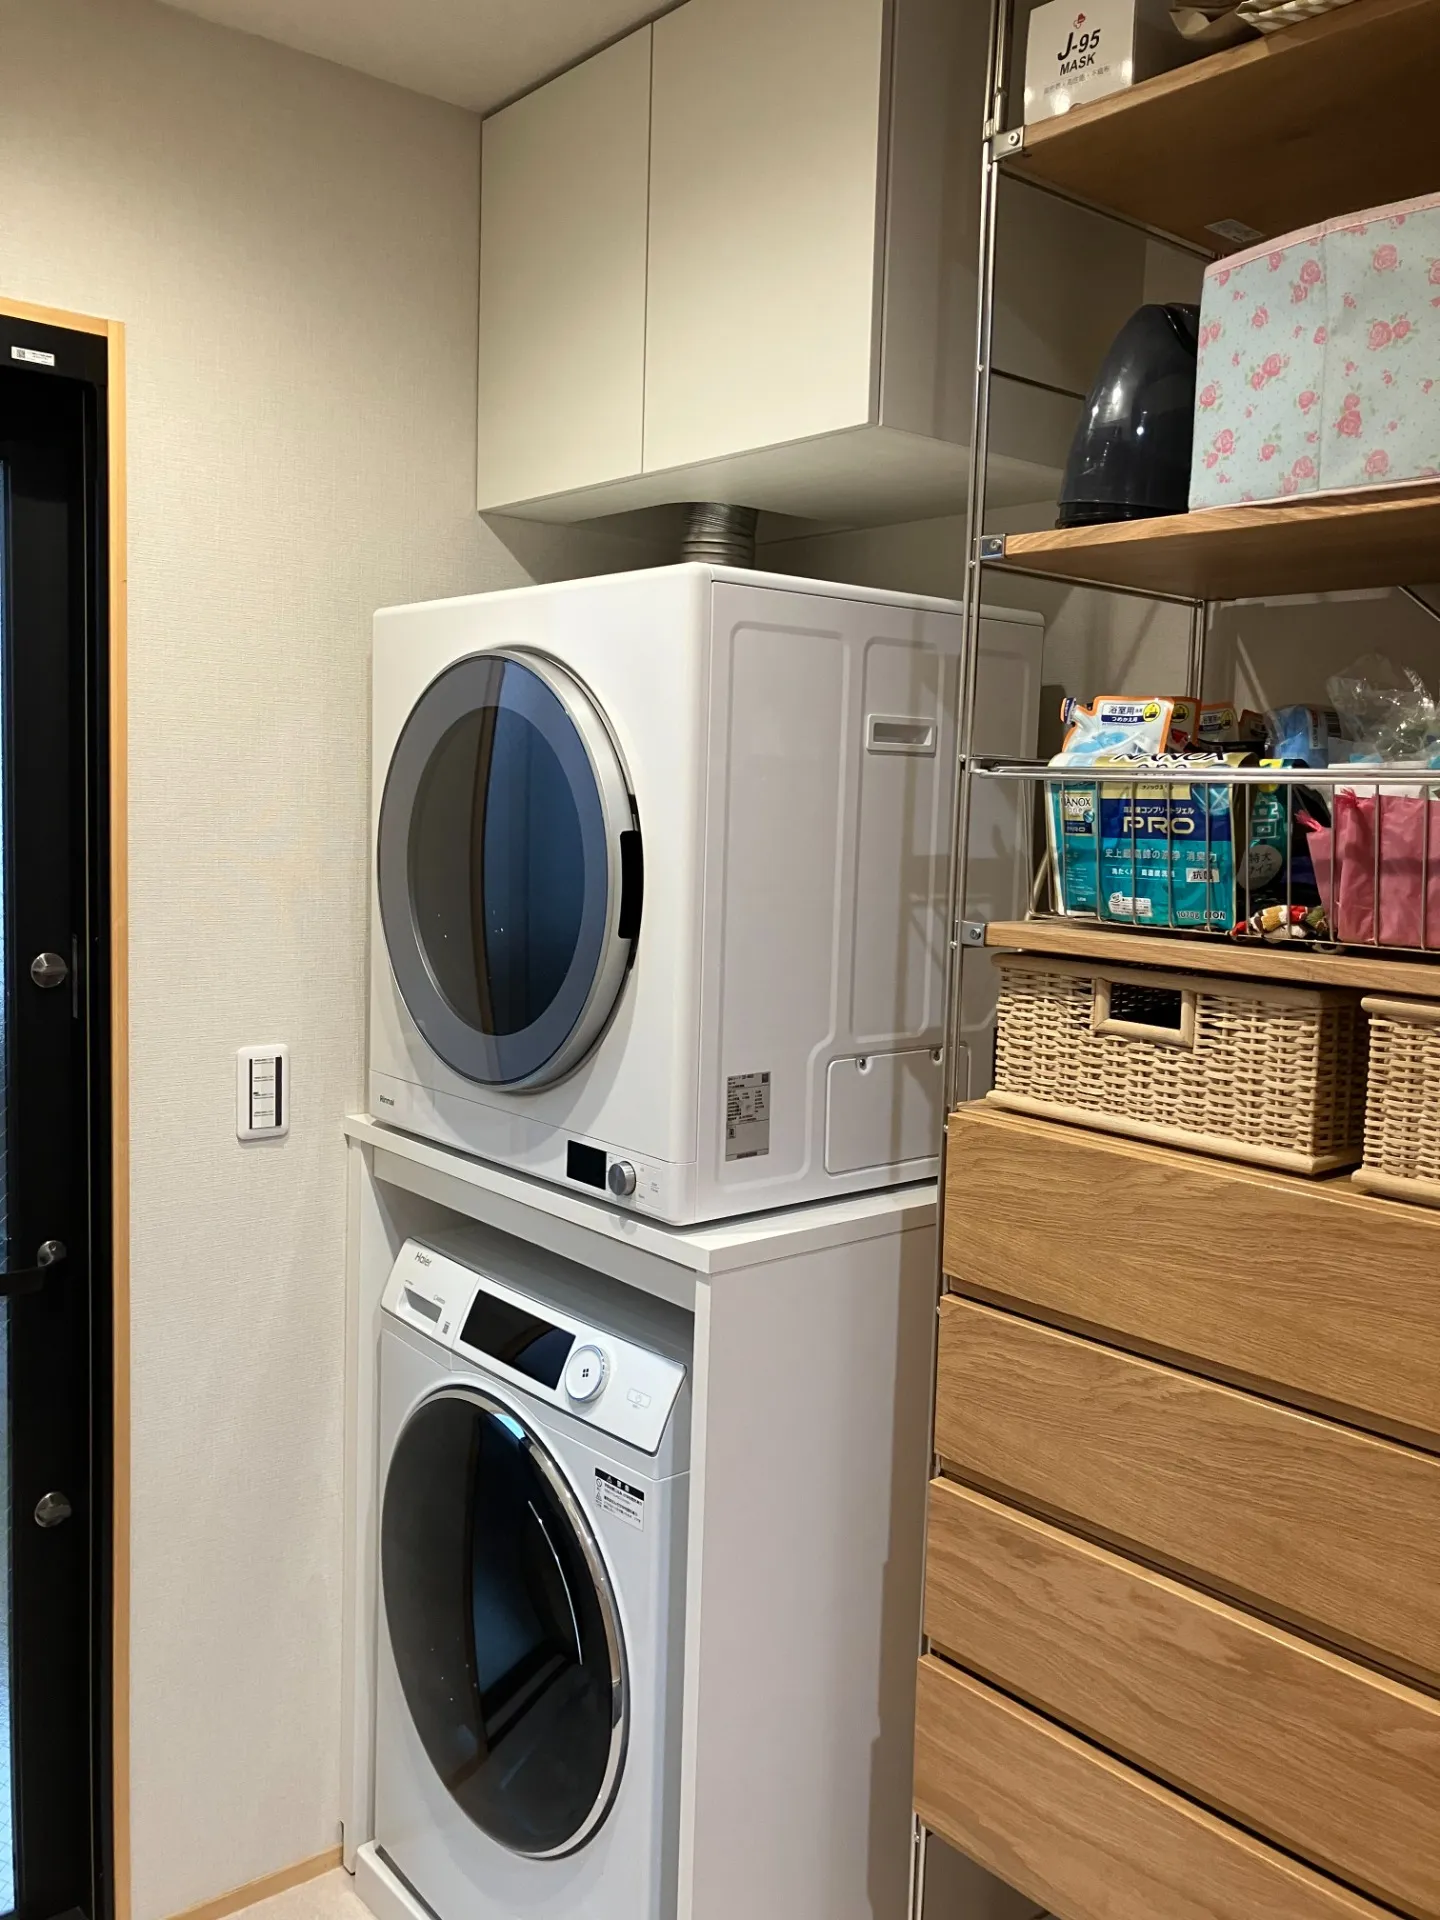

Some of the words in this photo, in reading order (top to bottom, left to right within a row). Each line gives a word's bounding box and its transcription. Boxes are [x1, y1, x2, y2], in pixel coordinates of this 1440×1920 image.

[1057, 28, 1101, 60] J-95
[1059, 52, 1096, 76] MASK
[1123, 816, 1195, 835] PRO
[415, 1251, 432, 1267] Haier
